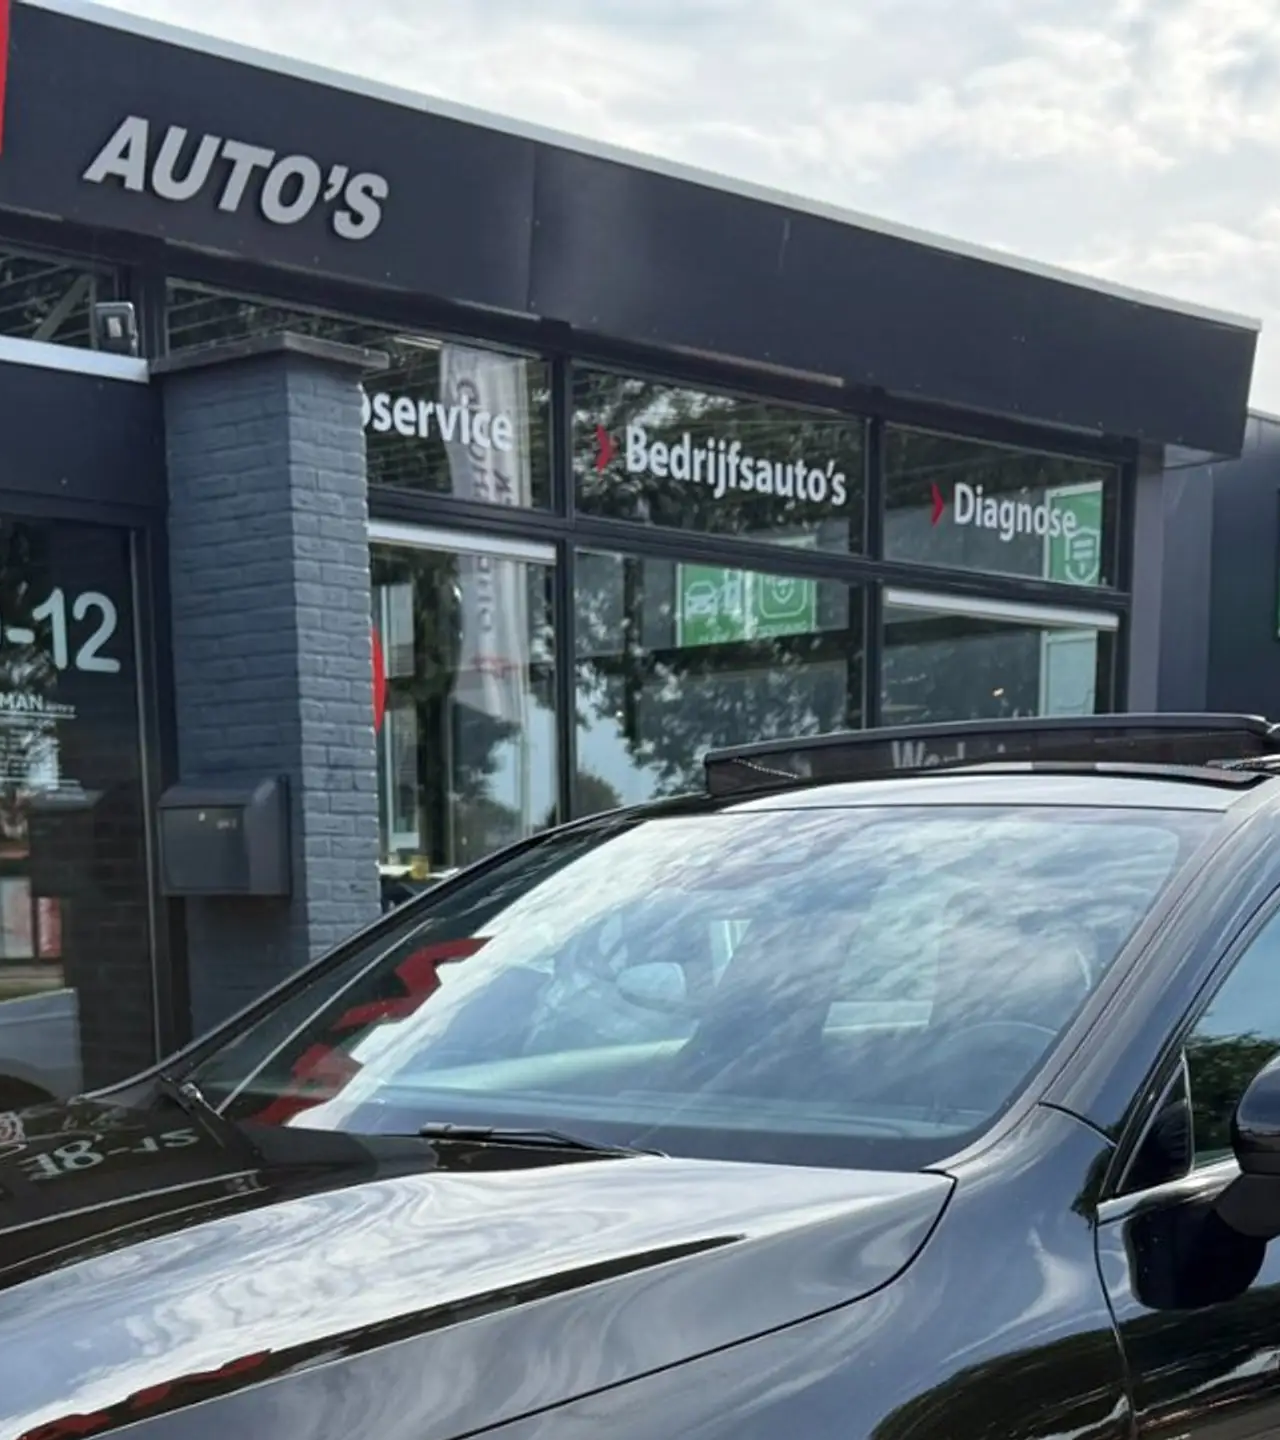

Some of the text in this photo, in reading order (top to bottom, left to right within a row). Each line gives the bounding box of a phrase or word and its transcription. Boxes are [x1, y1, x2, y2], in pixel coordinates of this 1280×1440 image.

[83, 115, 389, 240] AUTO'S
[626, 425, 847, 505] Bedrijfsauto's
[954, 482, 1077, 541] Diagnose
